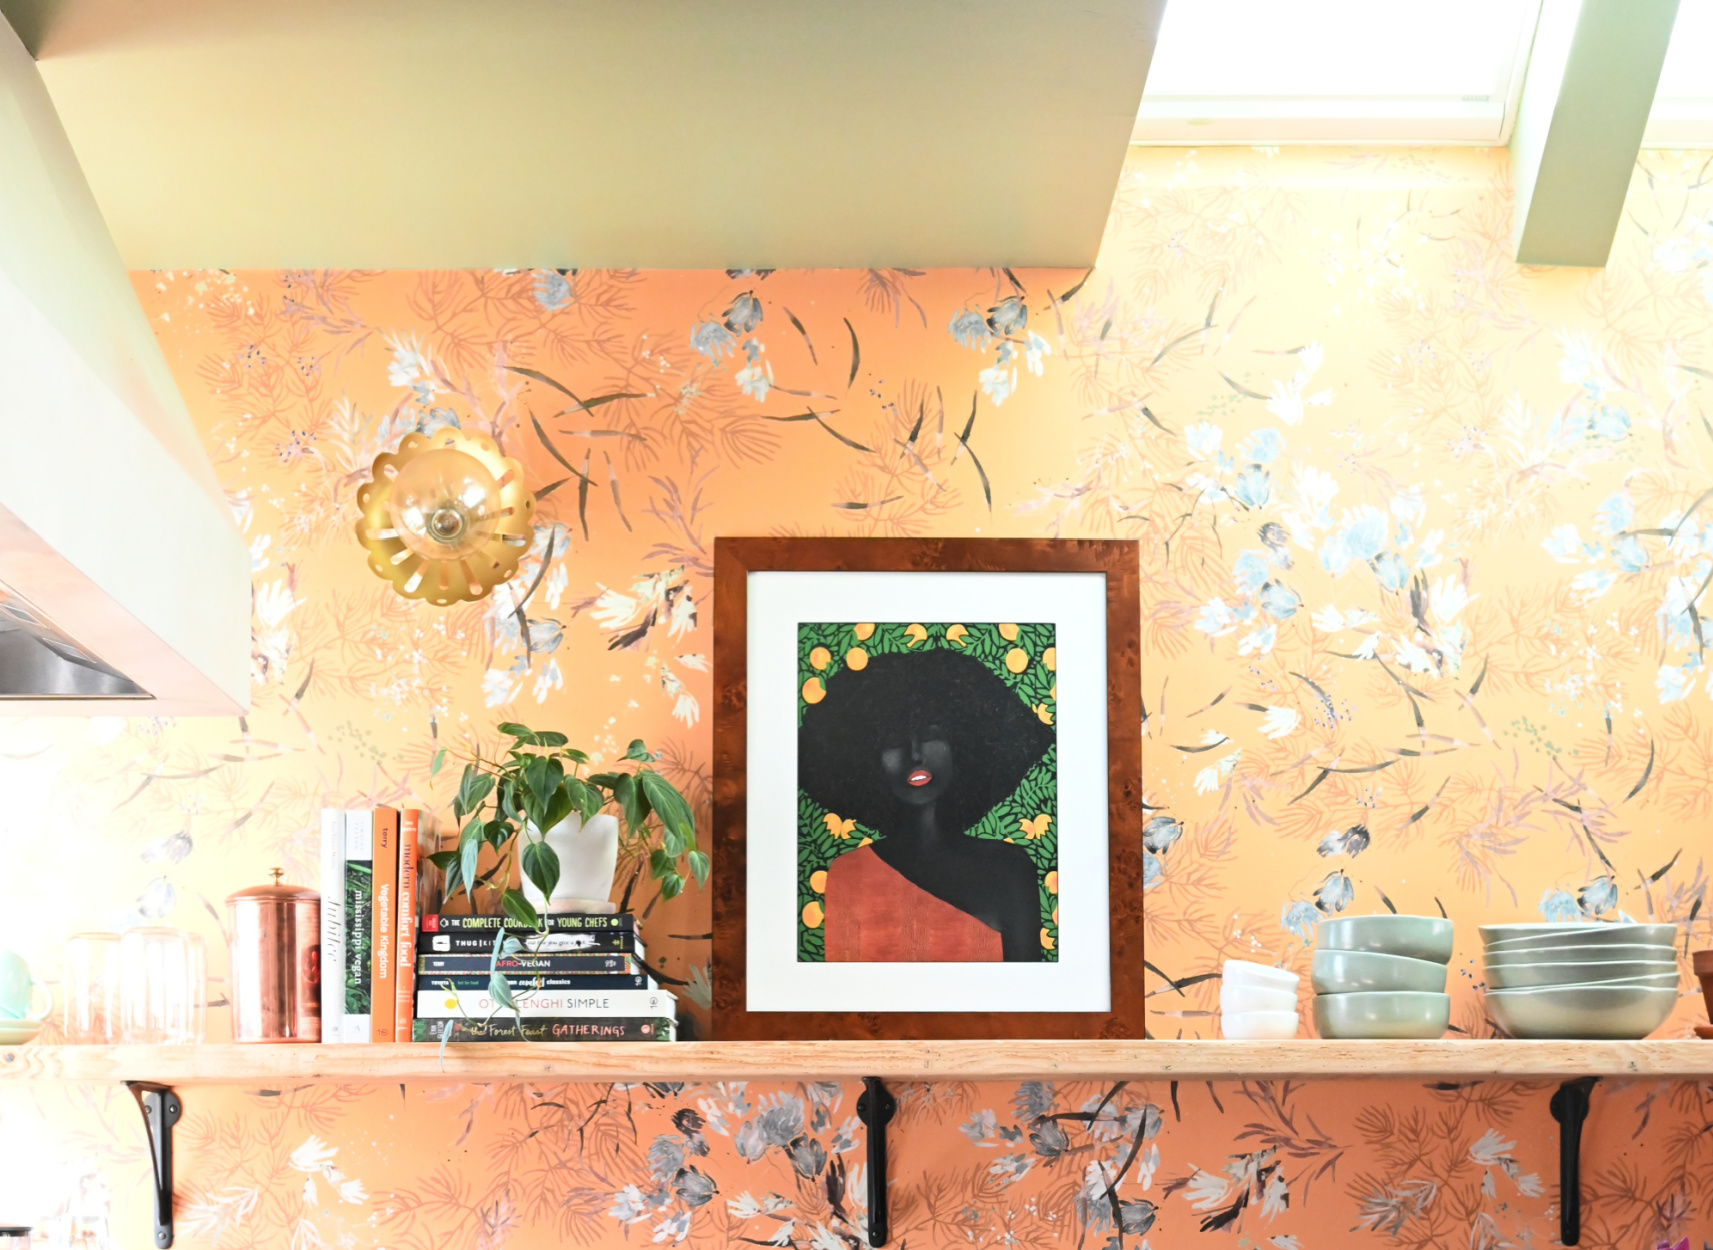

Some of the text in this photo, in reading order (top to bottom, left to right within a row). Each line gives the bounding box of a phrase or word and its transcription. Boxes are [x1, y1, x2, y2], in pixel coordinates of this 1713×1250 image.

[380, 828, 389, 848] terry
[403, 844, 414, 889] modern
[401, 891, 413, 937] comfort
[462, 917, 501, 928] COMPLETE
[504, 917, 543, 928] COOKK
[557, 917, 582, 928] YOUNG
[585, 917, 608, 928] CHEFS
[326, 896, 342, 962] Jubilee
[352, 890, 364, 985] mississippi vegan
[377, 884, 389, 979] Vegetable Kingdom
[400, 941, 412, 967] food
[496, 959, 551, 968] AFRO-VEGAN
[479, 998, 610, 1009] OTLENGHI SIMPLE
[489, 1023, 516, 1037] Forest
[520, 1023, 548, 1037] Feast
[552, 1023, 626, 1037] GATHERINGS
